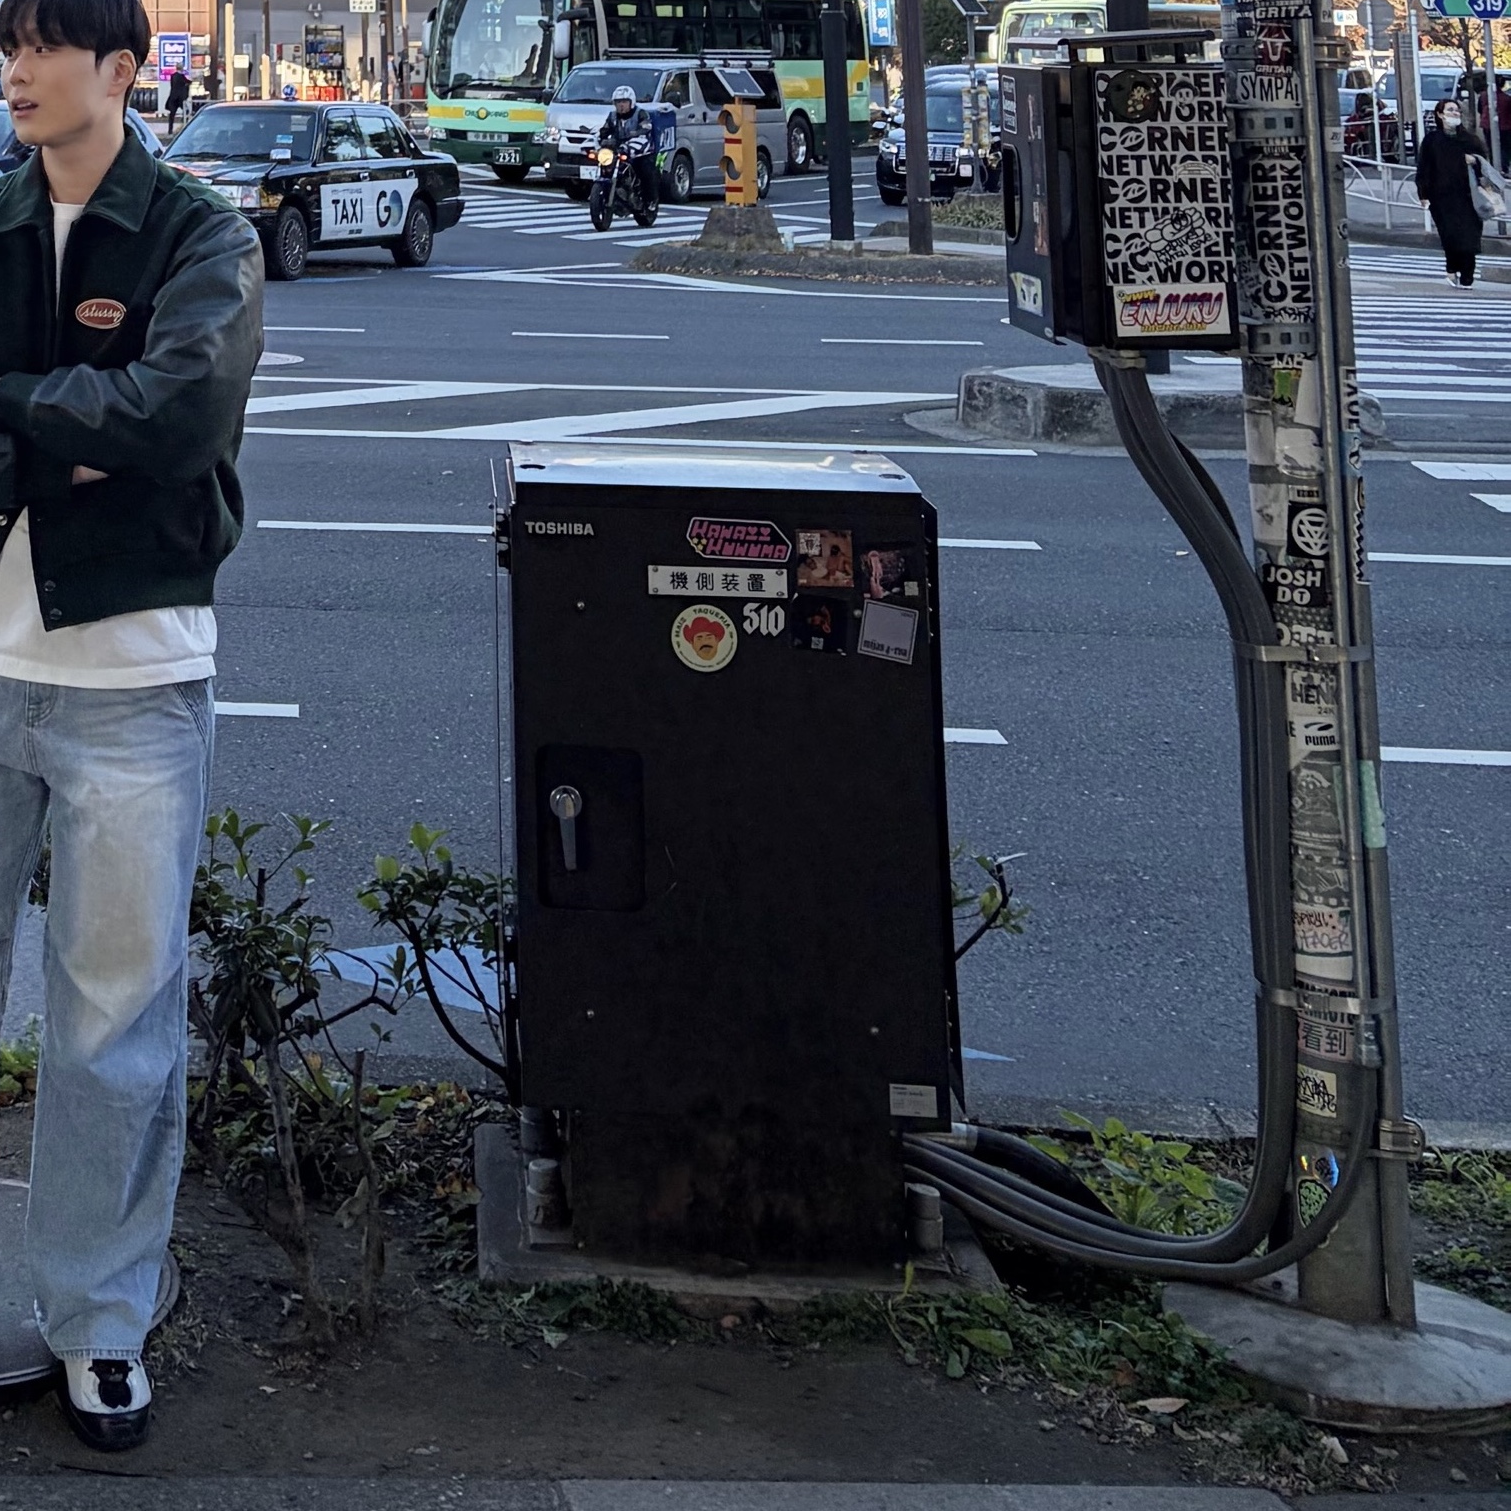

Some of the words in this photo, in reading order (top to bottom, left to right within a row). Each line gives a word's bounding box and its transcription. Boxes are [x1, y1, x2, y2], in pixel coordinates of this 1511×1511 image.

[1256, 5, 1313, 19] GRITA
[331, 197, 363, 226] TAXI
[1251, 162, 1288, 304] CORNER
[1280, 162, 1314, 304] NETWORK
[1120, 292, 1224, 327] ENJUKU
[524, 521, 595, 536] TOSHIBA
[691, 520, 771, 542] KAWAII
[670, 571, 766, 593] 機側装置
[1267, 566, 1322, 588] JOSH
[1305, 735, 1337, 746] PUMA
